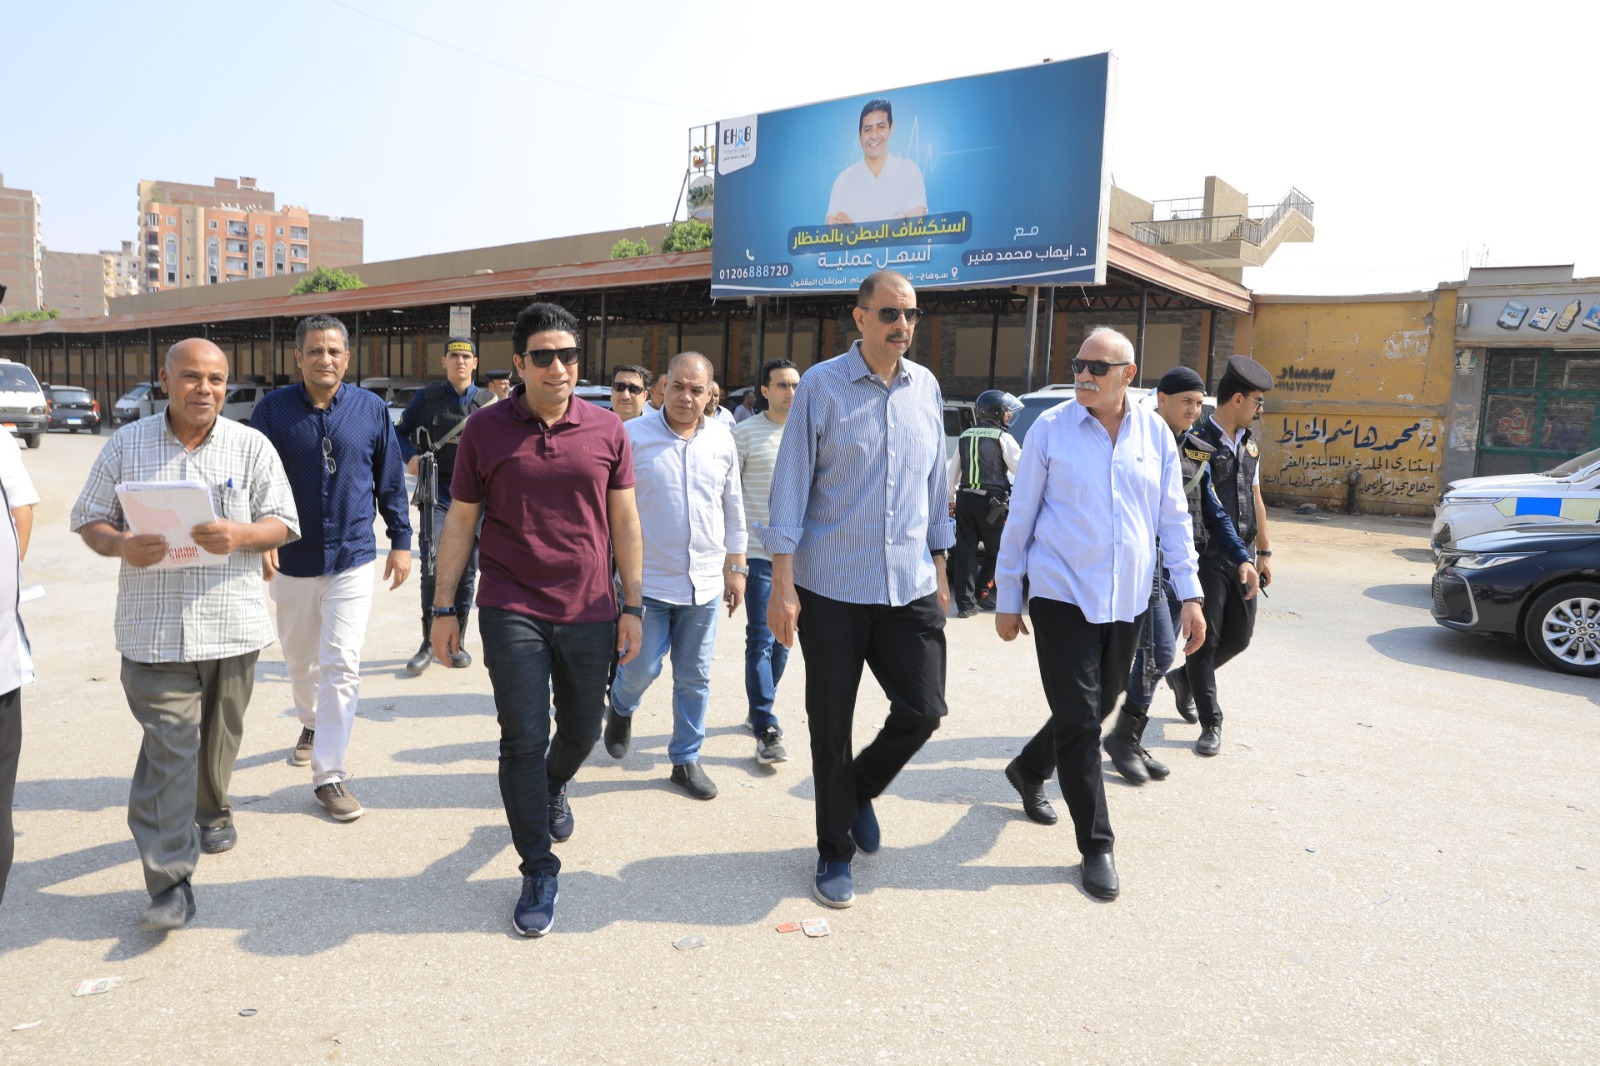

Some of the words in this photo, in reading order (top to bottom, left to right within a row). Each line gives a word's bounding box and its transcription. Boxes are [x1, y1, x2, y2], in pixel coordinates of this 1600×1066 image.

[846, 223, 889, 245] البطن
[891, 216, 966, 238] استكشاف
[1013, 225, 1039, 241] مع
[792, 228, 844, 250] بالمنظار
[817, 250, 873, 271] عملية
[876, 238, 932, 269] أسهل
[967, 250, 993, 266] منير
[995, 250, 1033, 261] محمد
[1035, 244, 1073, 262] ايهاب
[719, 264, 789, 280] 01206888720
[789, 278, 818, 288] المقفول
[1276, 365, 1336, 381] سمسار
[1275, 416, 1327, 449] الخياط
[1324, 419, 1378, 455] هاشم
[1370, 422, 1421, 451] محمد
